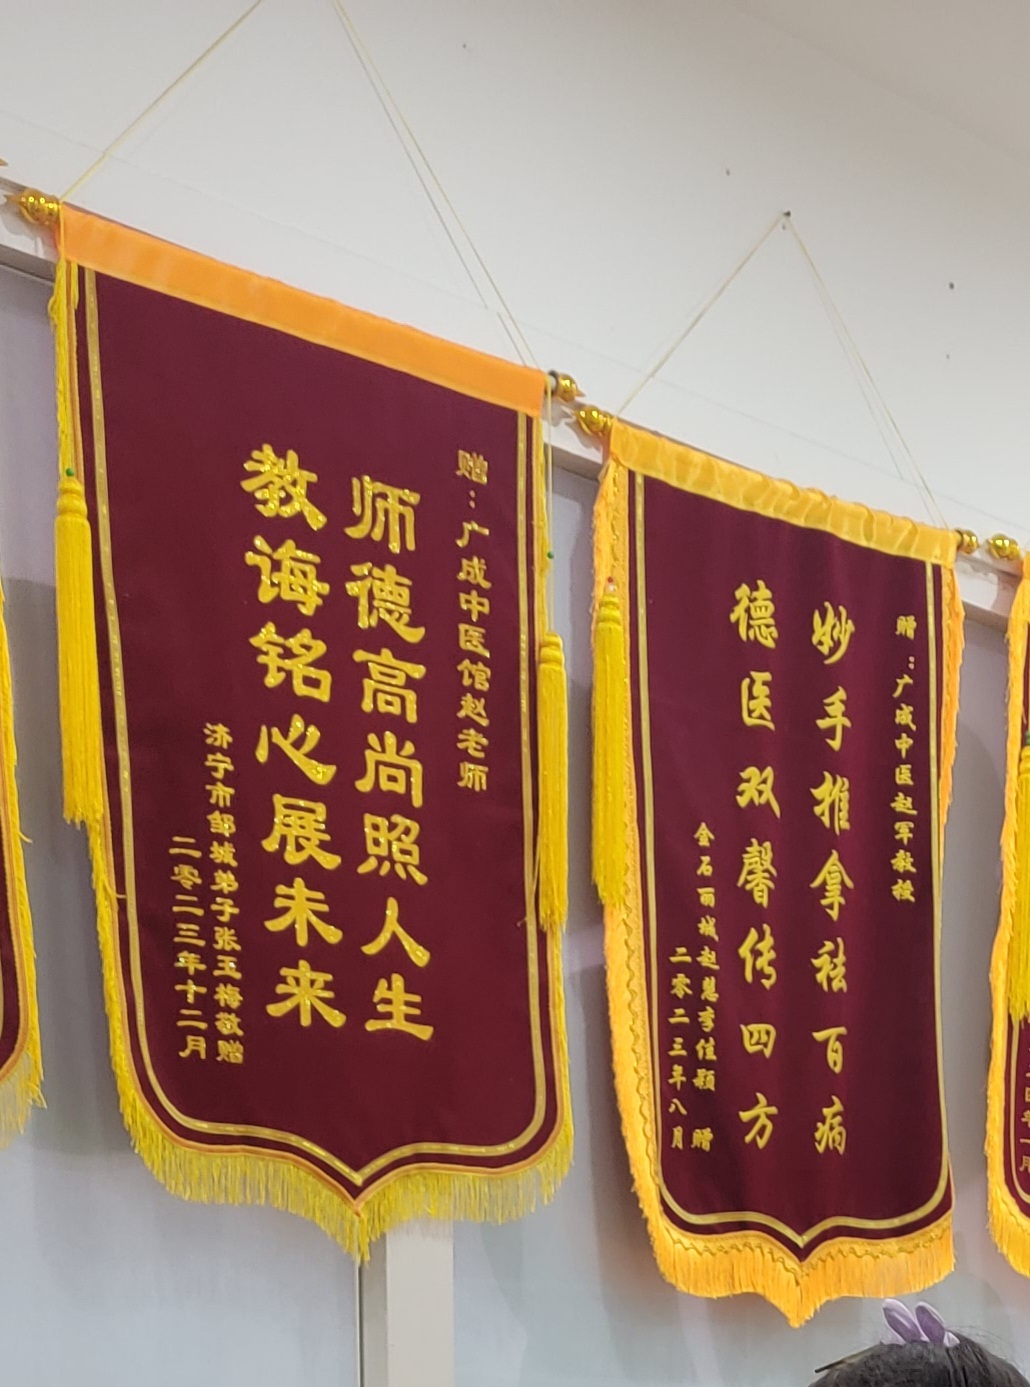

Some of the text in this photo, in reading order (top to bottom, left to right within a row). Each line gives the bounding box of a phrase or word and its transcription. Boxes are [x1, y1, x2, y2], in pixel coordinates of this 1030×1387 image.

[168, 835, 207, 1061] 二零二三年十二月
[240, 443, 347, 1028] 教诲铭心展未来
[344, 474, 434, 1041] 师德高尚照人生
[729, 578, 781, 1150] 德医双馨传四方
[810, 600, 856, 1154] 妙手推拿祛百病
[668, 945, 693, 1150] 二零二三年八月
[691, 1125, 715, 1152] 赠
